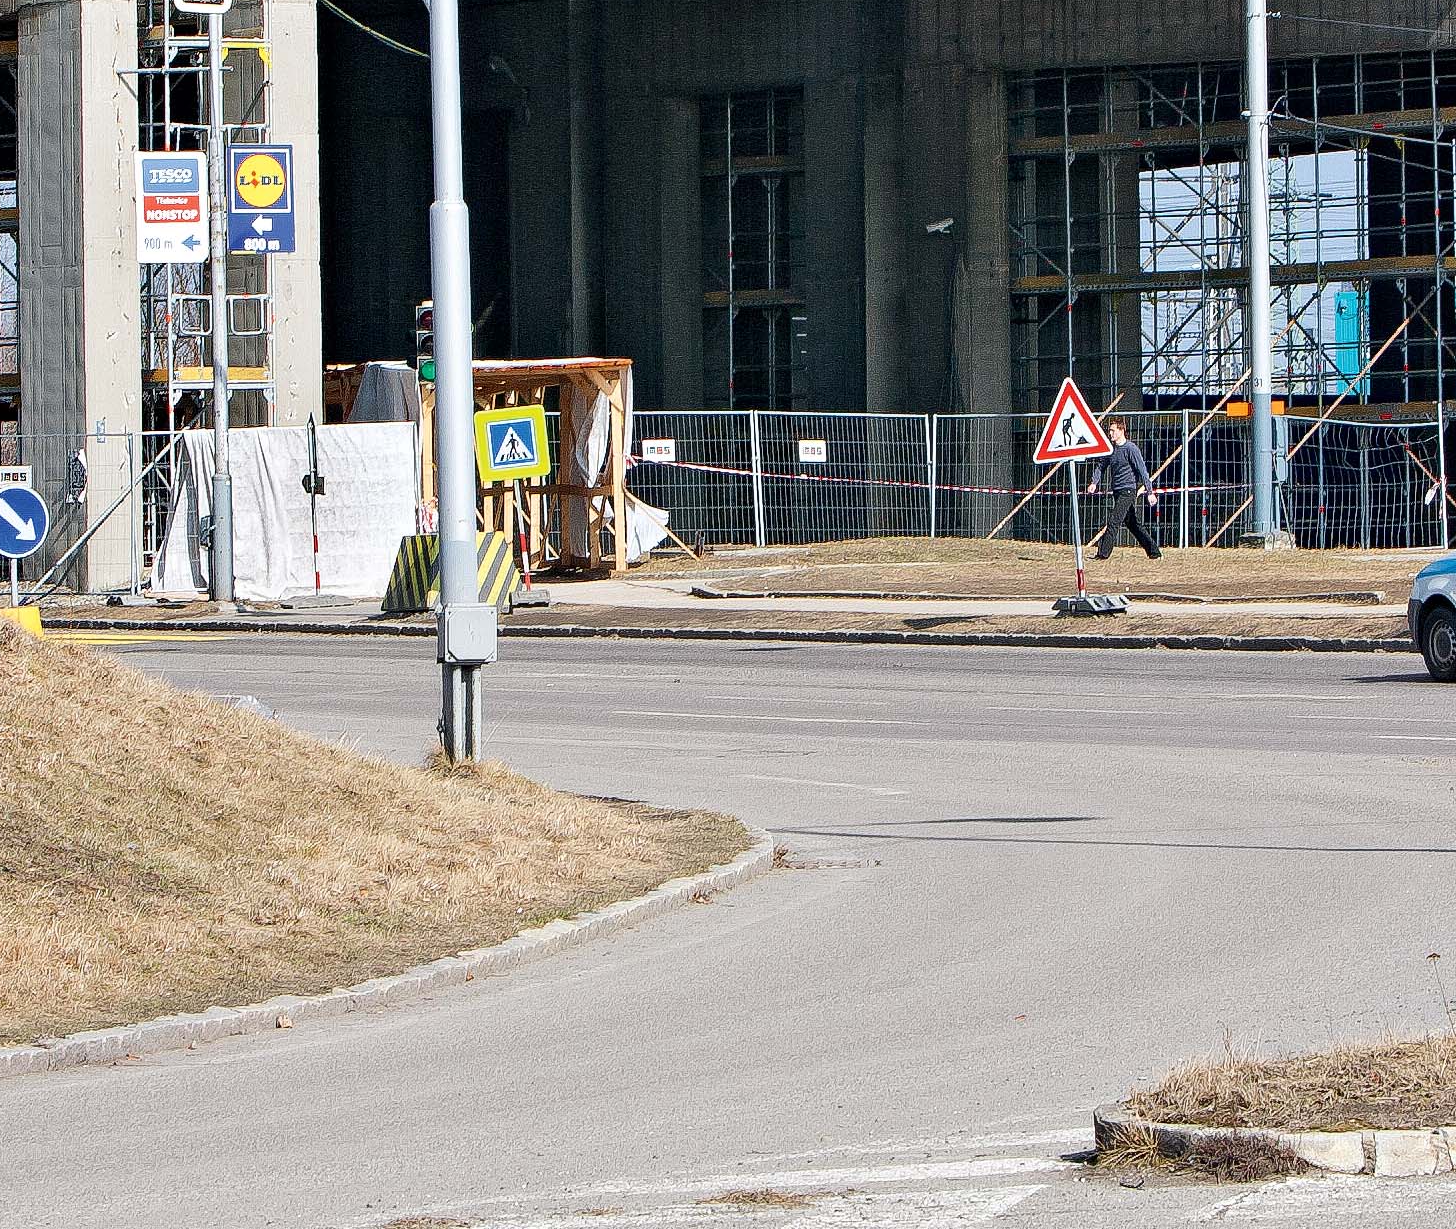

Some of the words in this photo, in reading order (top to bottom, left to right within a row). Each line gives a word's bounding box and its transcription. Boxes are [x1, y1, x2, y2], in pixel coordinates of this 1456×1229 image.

[149, 167, 193, 184] TESCO
[146, 209, 199, 221] NONSTOP
[144, 237, 161, 250] 900
[164, 240, 173, 250] m
[244, 237, 266, 251] 800
[268, 239, 280, 251] m
[1253, 377, 1263, 387] 31
